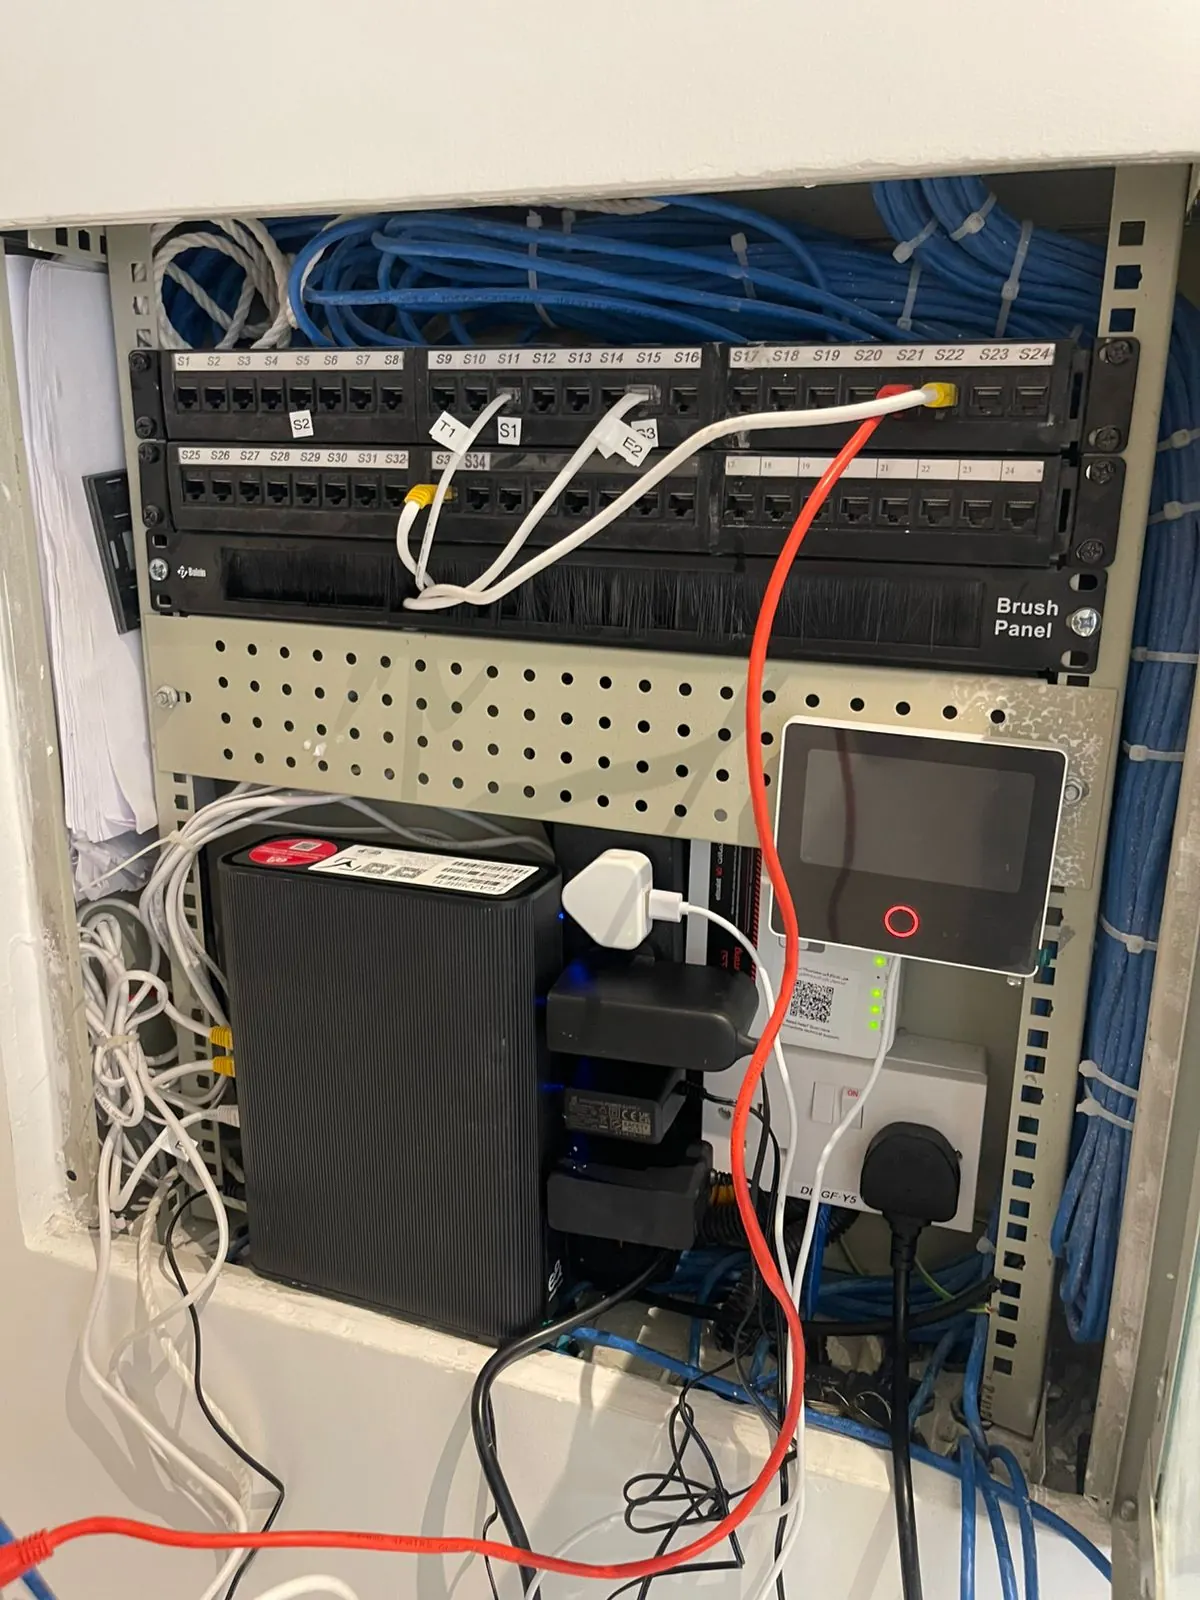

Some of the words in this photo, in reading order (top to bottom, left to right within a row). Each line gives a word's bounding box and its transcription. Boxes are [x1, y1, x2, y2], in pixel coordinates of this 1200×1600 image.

[178, 357, 190, 366] S1
[207, 357, 220, 366] S2
[237, 357, 251, 366] S3
[265, 356, 278, 366] S4
[296, 356, 310, 365] S5
[324, 355, 338, 365] S6
[356, 355, 370, 365] S7
[385, 355, 398, 365] S8
[436, 354, 452, 364] S9
[463, 354, 486, 365] S10
[498, 354, 520, 364] S11
[533, 353, 556, 364] S12
[568, 352, 592, 363] S13
[600, 352, 623, 363] S14
[636, 352, 661, 363] S15
[674, 351, 699, 363] S16
[733, 351, 757, 362] S17
[772, 351, 799, 362] S18
[813, 350, 840, 362] S19
[854, 349, 882, 362] S20
[896, 349, 925, 361] S21
[935, 349, 965, 361] S22
[979, 348, 1009, 361] S23
[1019, 348, 1049, 360] S24
[293, 419, 310, 430] S2
[440, 420, 456, 438] T1
[499, 423, 517, 438] S1
[622, 436, 643, 458] E2
[181, 450, 200, 460] S25
[211, 450, 230, 460] S26
[240, 451, 259, 461] S27
[270, 451, 290, 461] S28
[300, 452, 320, 462] S29
[327, 452, 347, 463] S30
[358, 453, 377, 464] S31
[385, 453, 406, 464] S32
[464, 454, 486, 470] S34
[922, 465, 930, 473] 22
[996, 597, 1059, 617] Brush
[994, 619, 1053, 639] Panel
[847, 1088, 859, 1098] ON
